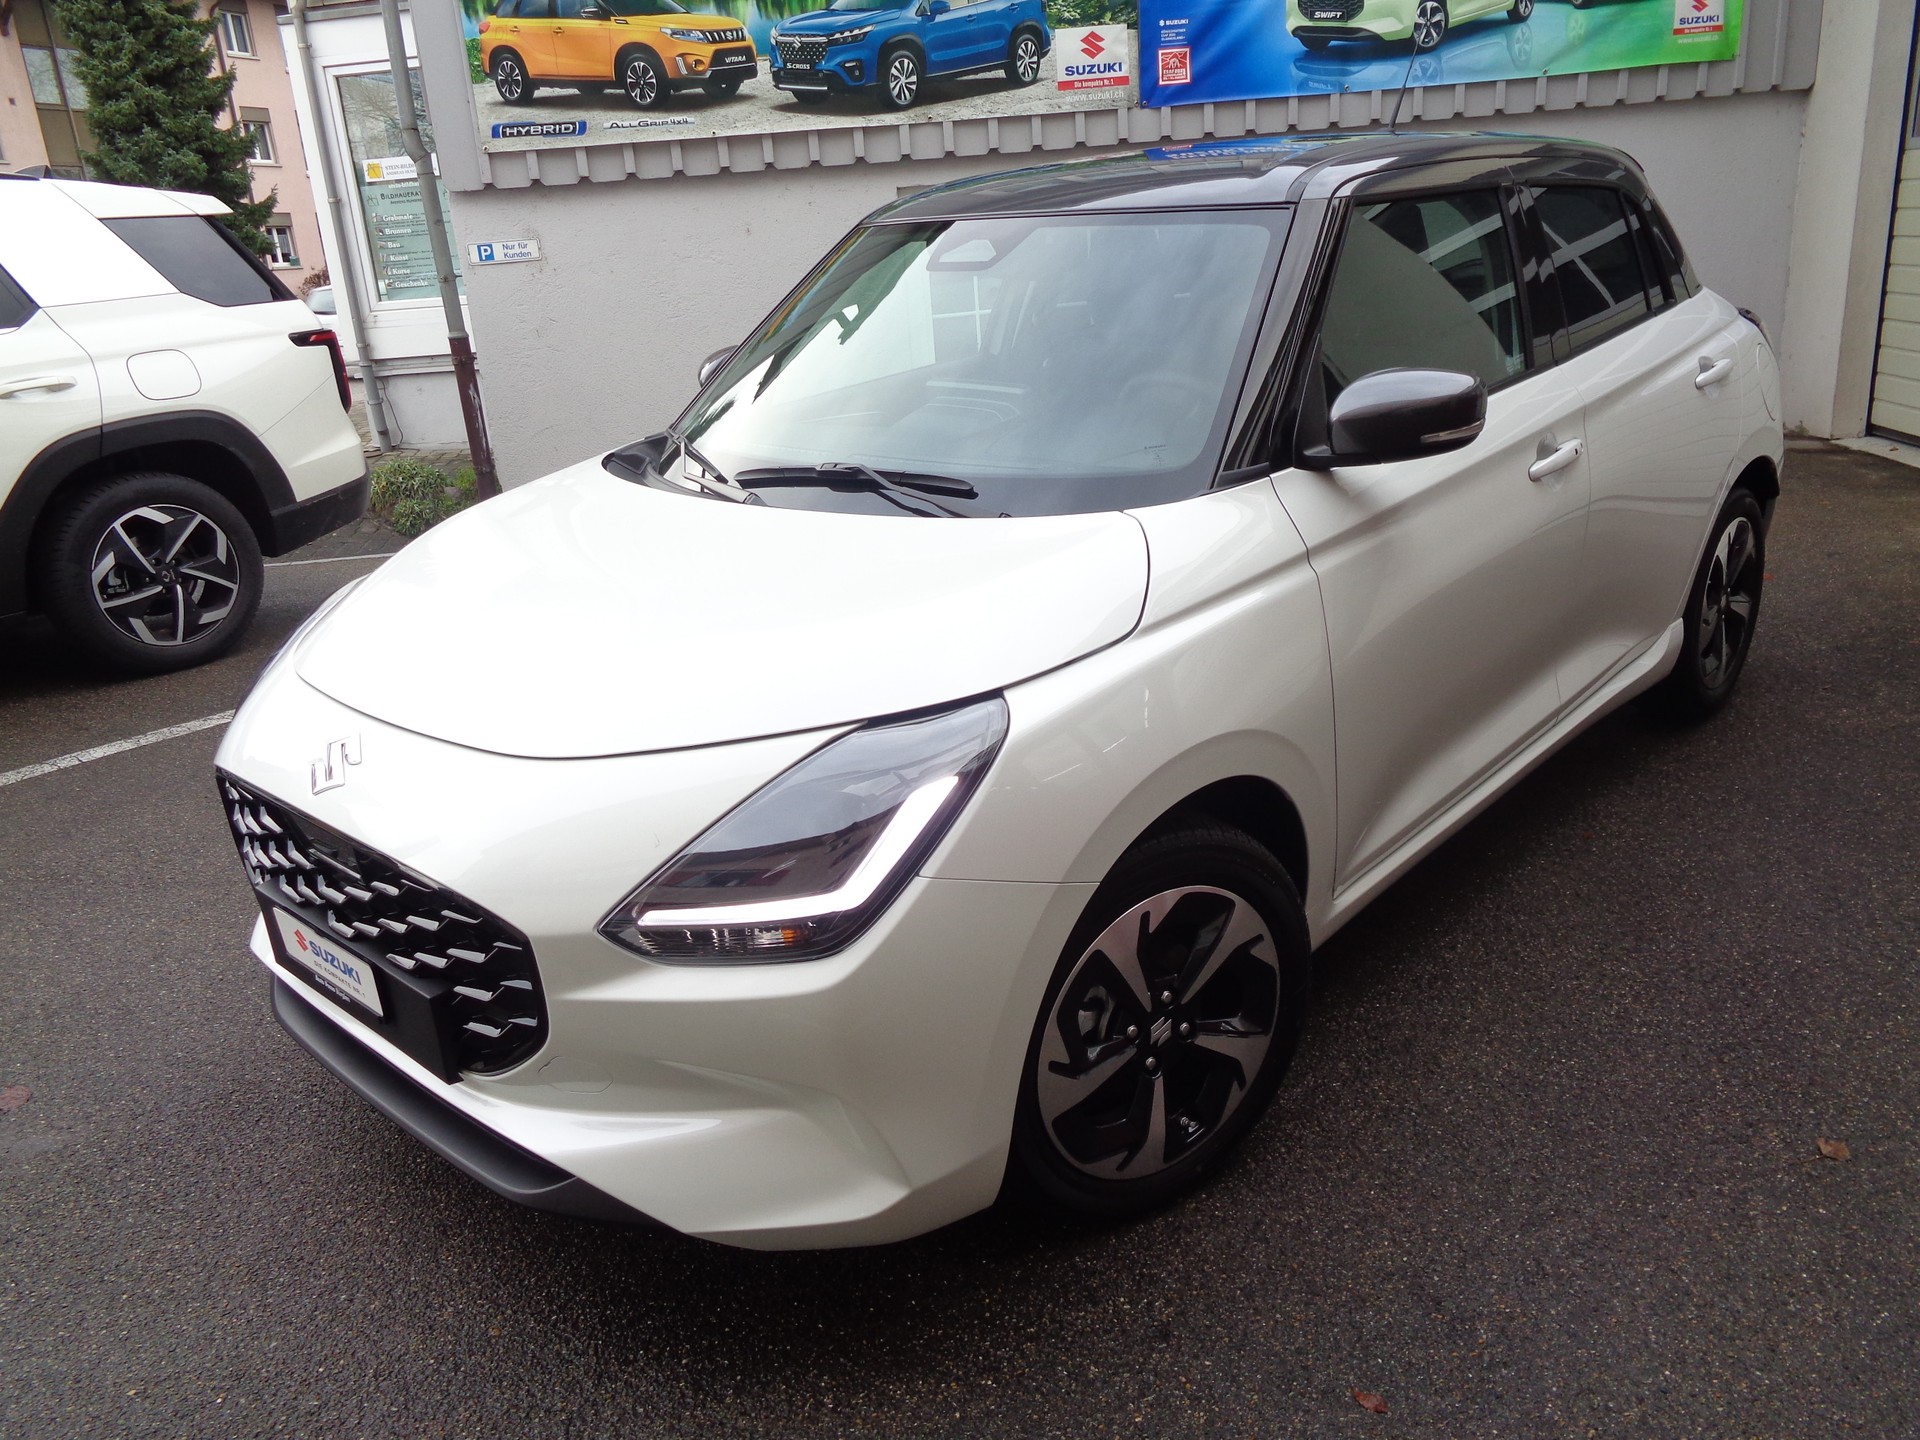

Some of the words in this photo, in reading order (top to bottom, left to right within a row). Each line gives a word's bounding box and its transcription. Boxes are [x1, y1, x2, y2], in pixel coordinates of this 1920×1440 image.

[1314, 11, 1342, 19] SWIFT
[1679, 15, 1720, 25] SUZUKI
[725, 55, 746, 63] VITARA
[786, 62, 811, 70] S-CROSS
[1065, 62, 1123, 77] SUZUKI
[1083, 80, 1103, 88] kompakte
[1066, 90, 1124, 103] www.suzuki.ch
[506, 123, 574, 136] HYBRID
[383, 213, 413, 222] Grabmale
[480, 246, 491, 260] P
[503, 251, 532, 259] Kunden
[395, 280, 428, 288] Geschenke
[309, 940, 361, 985] SUZUKI
